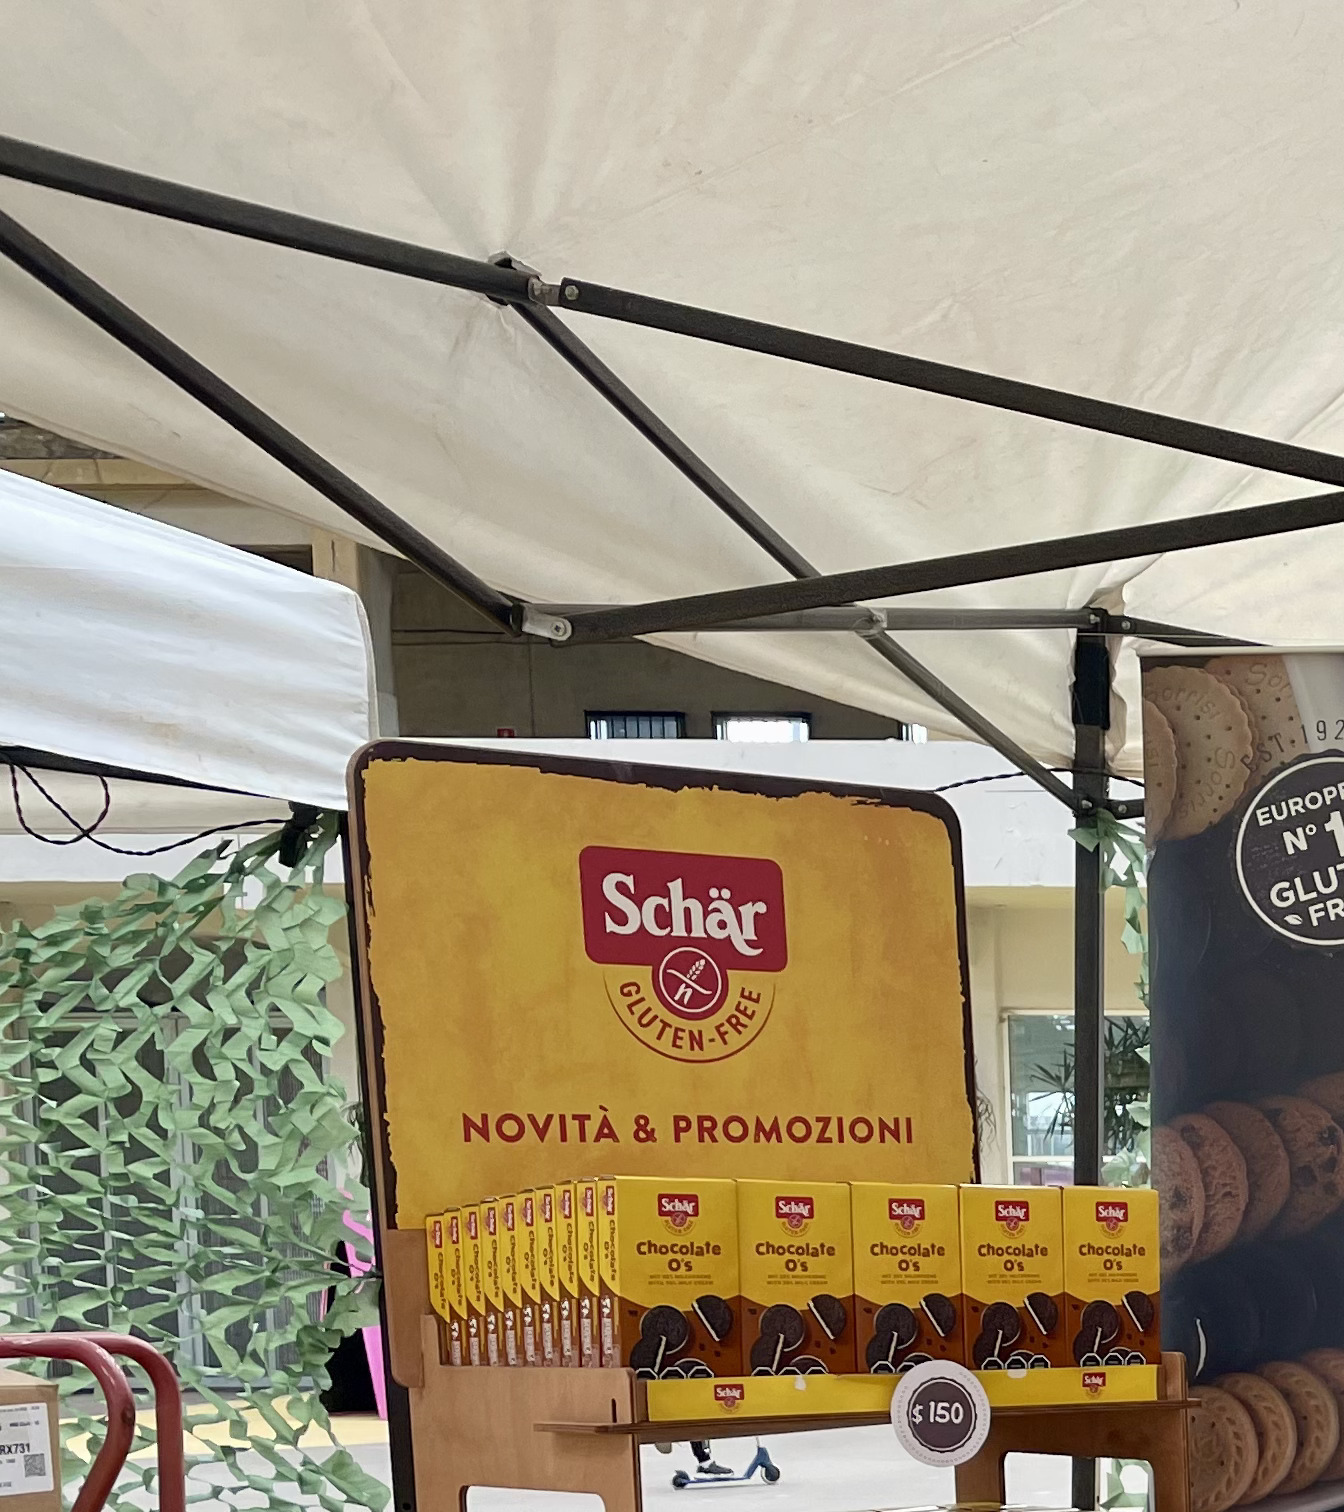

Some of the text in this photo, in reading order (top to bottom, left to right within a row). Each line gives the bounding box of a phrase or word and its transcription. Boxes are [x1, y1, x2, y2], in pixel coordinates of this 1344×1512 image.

[601, 872, 767, 956] Schär
[618, 980, 763, 1052] GLUTEN-FREE
[462, 1105, 914, 1145] NOVITÀ & PROMOZIONI
[661, 1198, 696, 1215] Schär
[778, 1201, 812, 1217] Schär
[891, 1202, 922, 1218] Schär
[998, 1204, 1027, 1219] Schär
[1098, 1205, 1127, 1220] Schär
[636, 1240, 722, 1257] Chocolate
[755, 1242, 836, 1257] Chocolate
[870, 1242, 946, 1258] Chocolate
[977, 1243, 1049, 1258] Chocolate
[1078, 1243, 1146, 1257] Chocolate
[929, 1401, 964, 1425] 150
